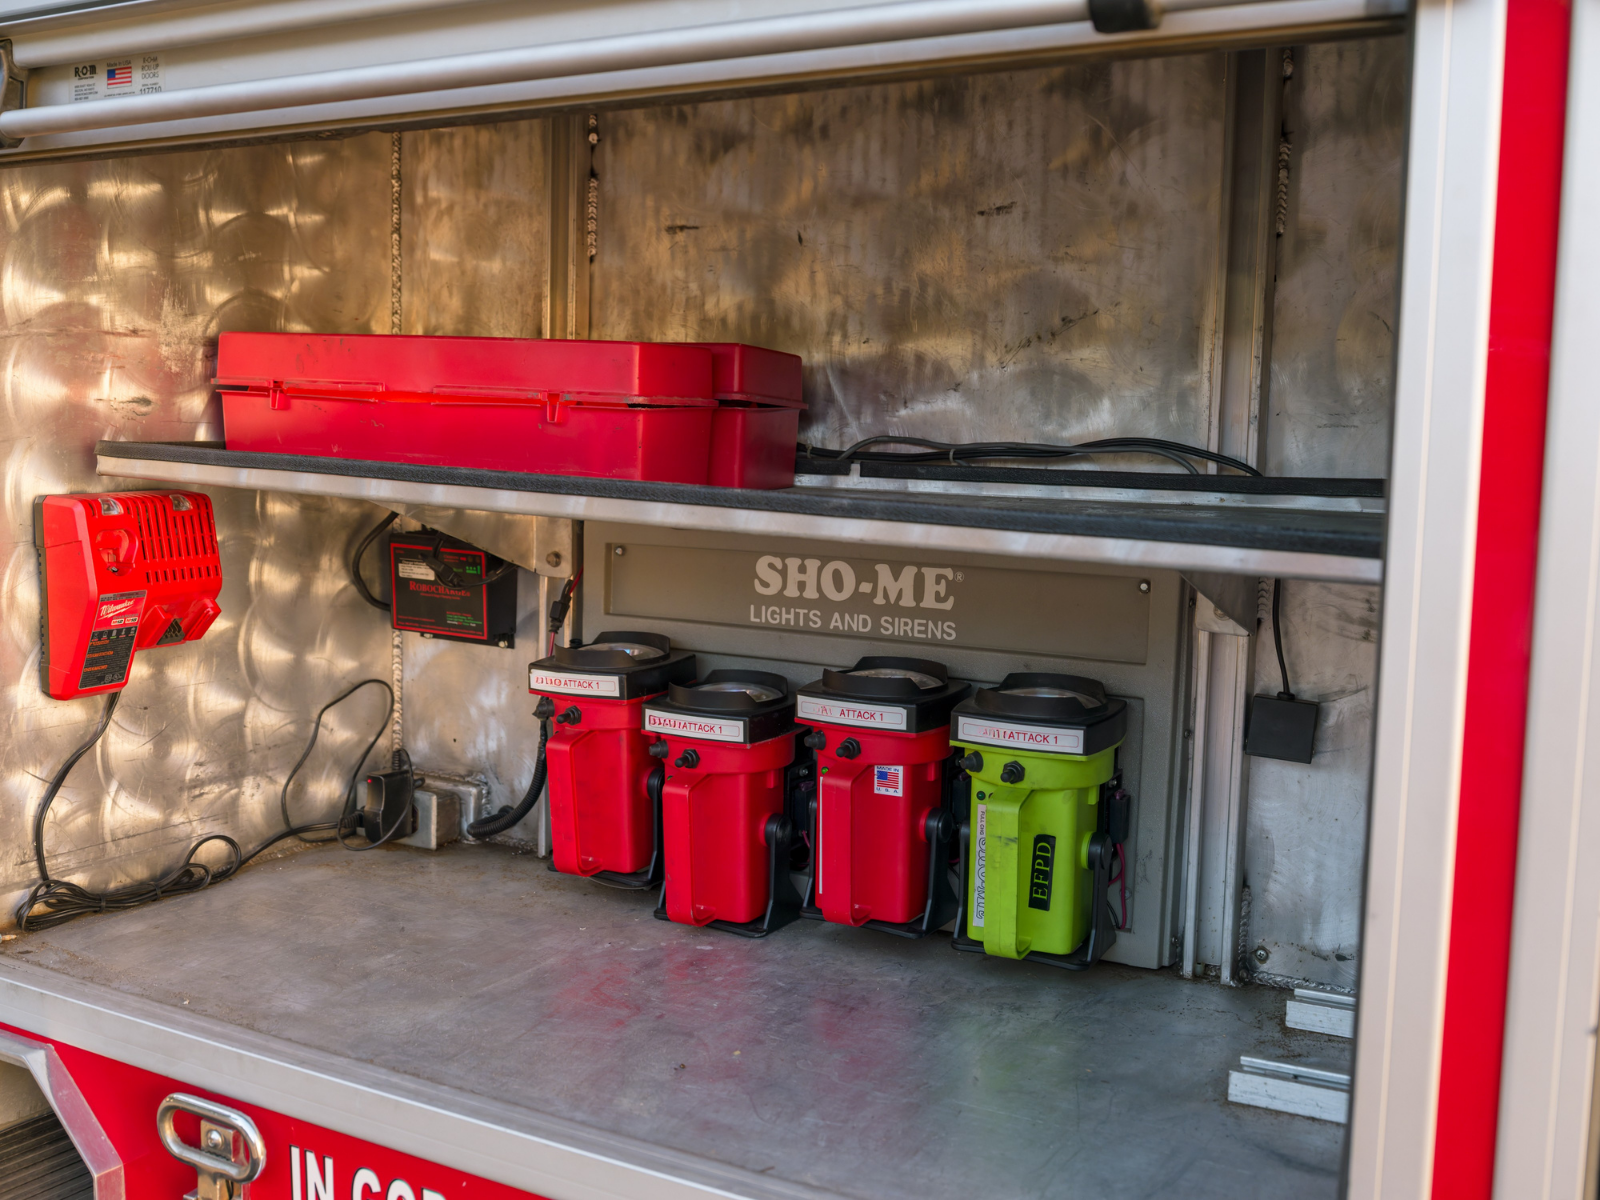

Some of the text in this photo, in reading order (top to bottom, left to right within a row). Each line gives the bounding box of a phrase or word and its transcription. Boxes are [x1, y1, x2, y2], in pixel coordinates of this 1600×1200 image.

[750, 604, 957, 641] LIGHTS AND SIRENS
[563, 679, 594, 690] ATTACK
[596, 681, 600, 690] 1
[839, 708, 877, 721] ATTACK
[880, 713, 884, 722] 1
[682, 722, 716, 734] ATTACK
[718, 725, 723, 734] 1
[1008, 731, 1050, 744] ATTACK
[1053, 735, 1058, 745] 1
[1032, 841, 1052, 900] EFPD
[289, 1144, 335, 1200] IN
